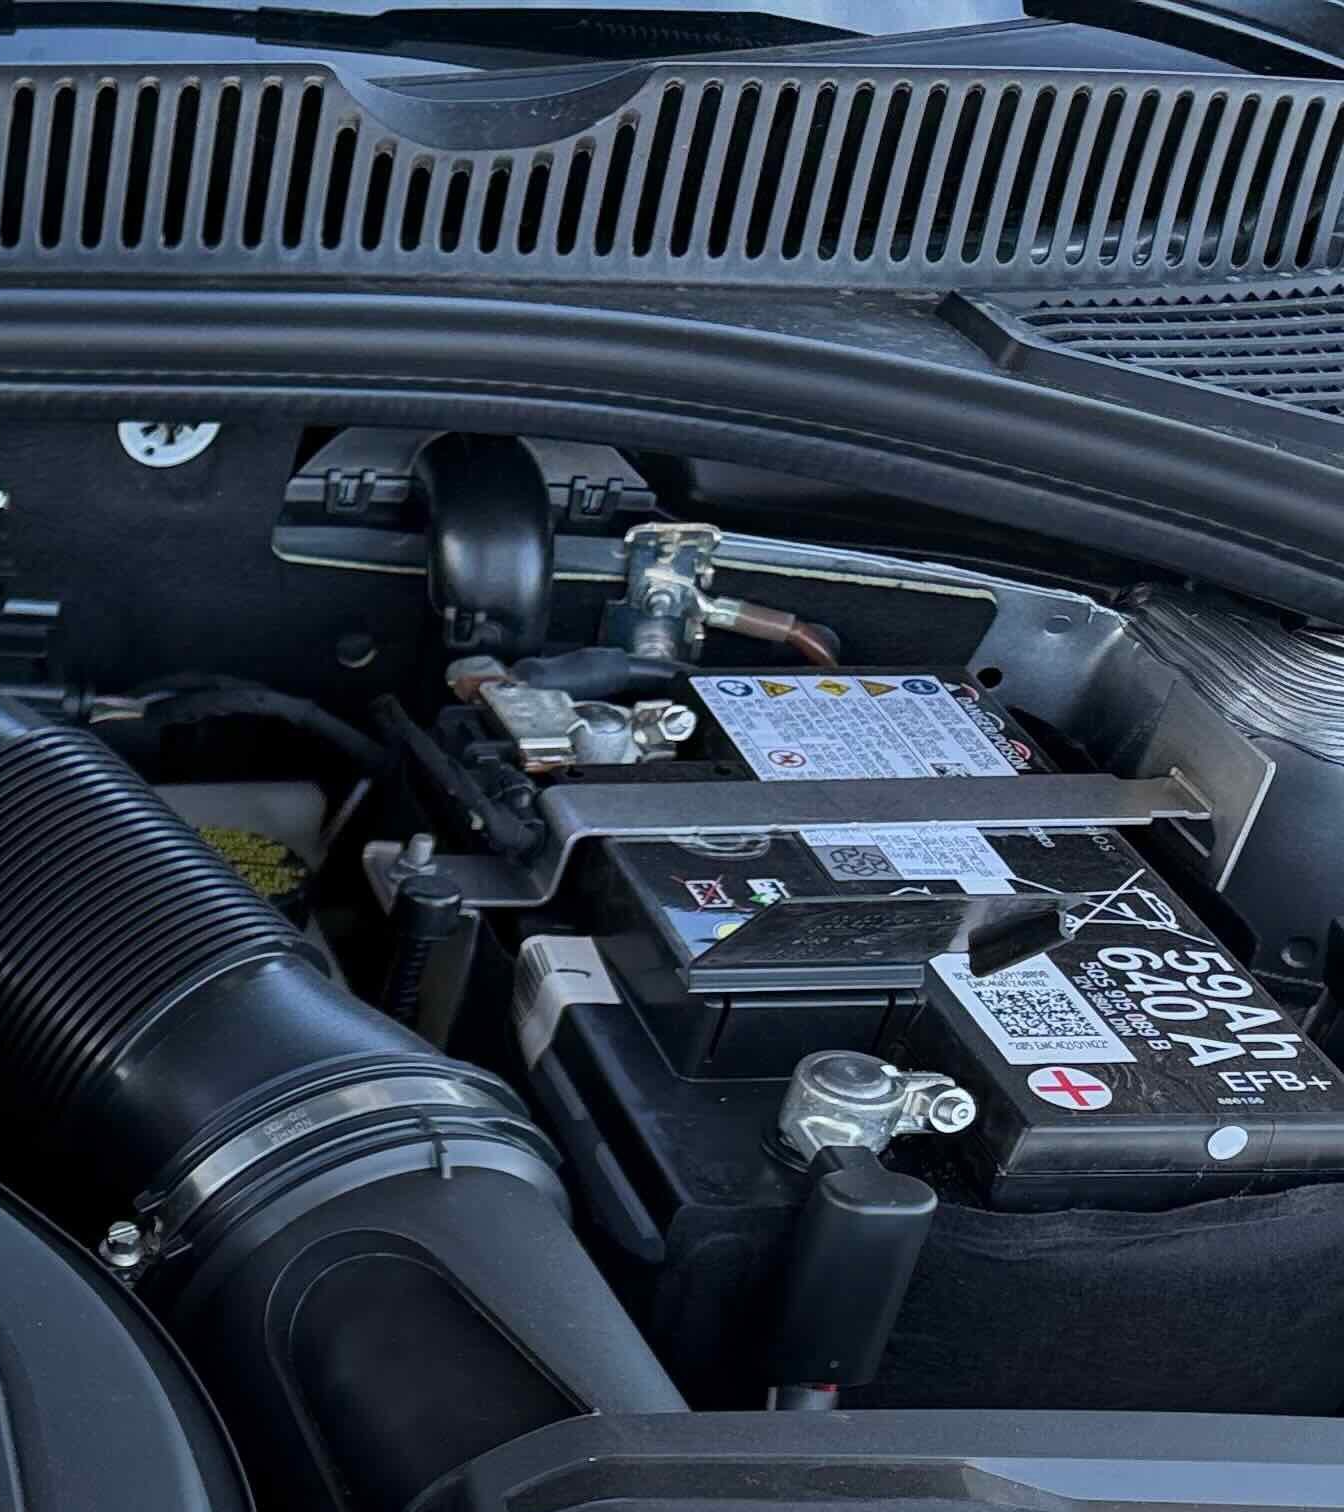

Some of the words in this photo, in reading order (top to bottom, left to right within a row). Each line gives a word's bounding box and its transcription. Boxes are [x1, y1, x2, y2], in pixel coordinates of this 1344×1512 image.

[1097, 947, 1209, 1021] 640
[1167, 1032, 1246, 1068] A
[1104, 989, 1139, 1011] 915
[1124, 1013, 1161, 1037] 089
[1146, 1039, 1173, 1051] B
[1108, 1017, 1138, 1037] DIN
[1164, 949, 1303, 1060] 59Ah
[1217, 1070, 1333, 1092] EFB+
